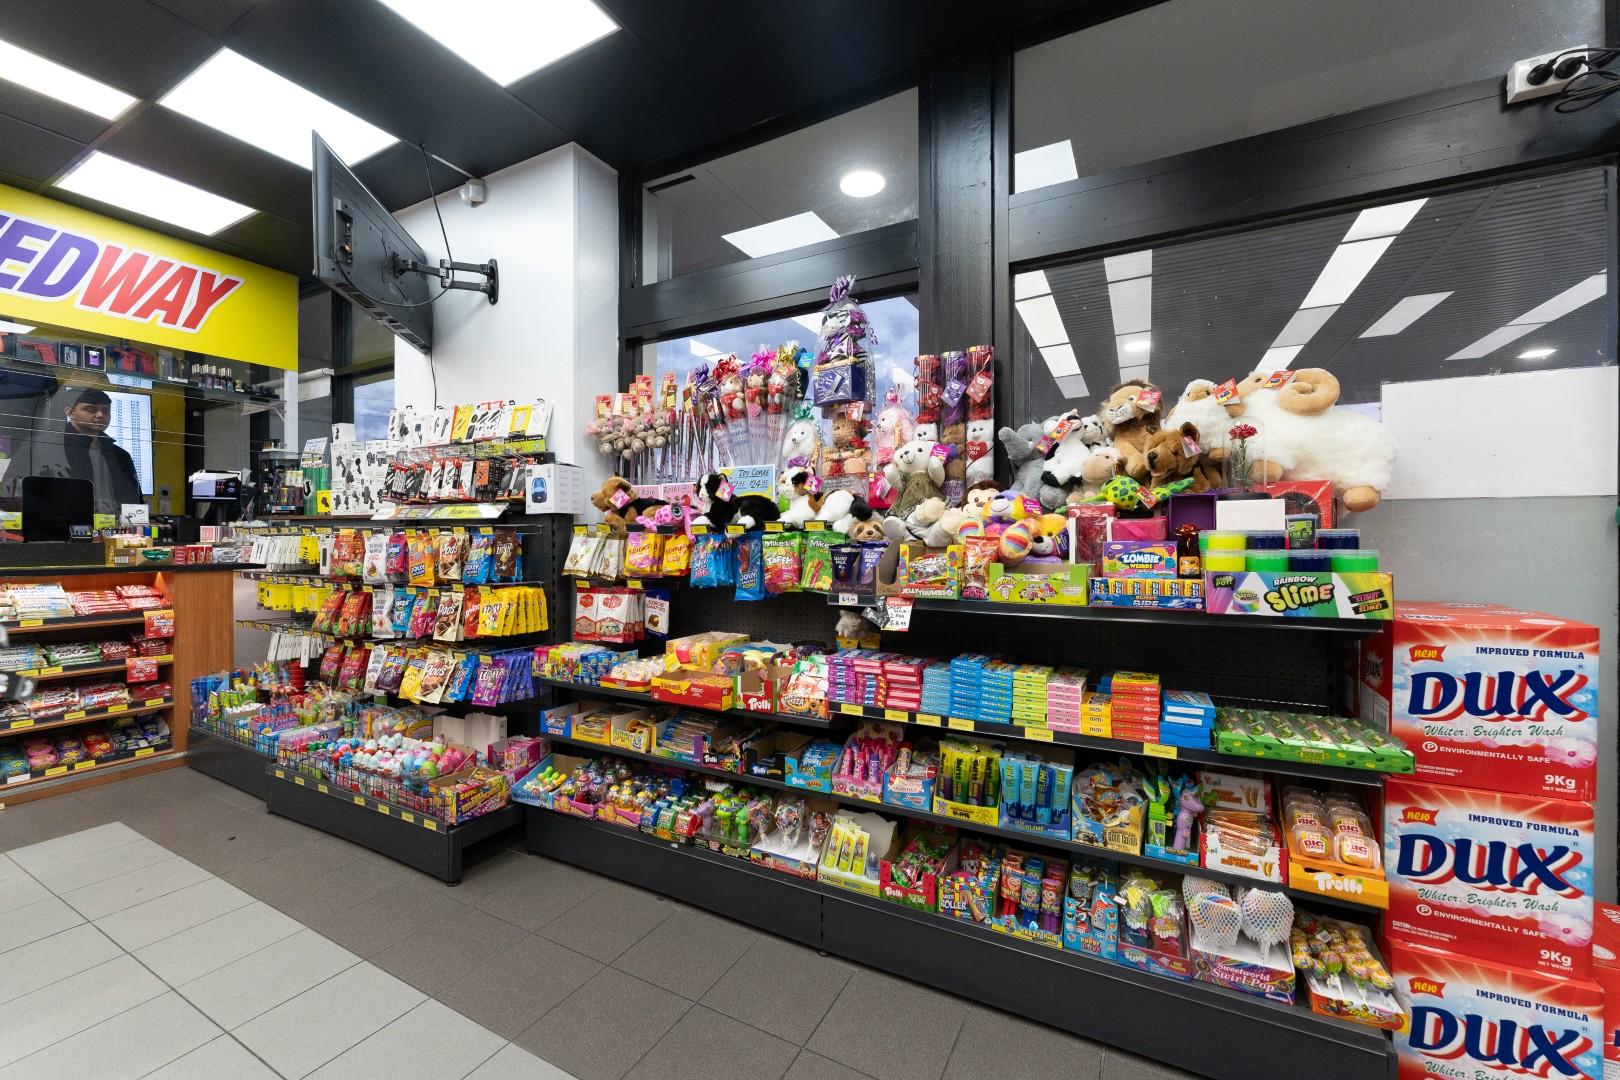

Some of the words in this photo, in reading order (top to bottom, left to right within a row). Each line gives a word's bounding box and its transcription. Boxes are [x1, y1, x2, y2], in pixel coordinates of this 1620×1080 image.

[1121, 553, 1161, 563] ZOMBIE
[1273, 576, 1317, 586] RAINBOW
[1414, 649, 1437, 658] new
[1476, 647, 1529, 657] IMPROVED
[1533, 649, 1585, 660] FORMULA
[1408, 670, 1576, 717] DUX
[748, 698, 771, 710] Trolli
[1473, 725, 1522, 739] Brighter
[1528, 724, 1564, 736] Wash
[1440, 746, 1524, 760] ENVIRONMENTALLY
[1544, 774, 1576, 789] 9Kg
[1298, 818, 1317, 826] BIG
[1407, 811, 1430, 823] new
[1339, 824, 1359, 832] BIG
[1468, 814, 1523, 829] IMPROVED
[1526, 822, 1580, 837] FORMULA
[1396, 833, 1570, 892] DUX
[1314, 872, 1363, 894] Trolli
[885, 887, 903, 897] Trolli
[941, 900, 967, 910] ROLLER
[1467, 894, 1517, 910] Brighter
[1522, 898, 1559, 912] Wash
[1434, 911, 1518, 933] ENVIRONMENTALLY
[1522, 929, 1547, 939] SAFE
[1540, 949, 1572, 966] 9Kg
[1217, 963, 1271, 982] Sweetworld
[1549, 963, 1573, 972] WEIGHT
[1414, 981, 1437, 993] new
[1476, 989, 1532, 1009] IMPROVED
[1535, 1003, 1589, 1022] FORMULA
[1409, 1005, 1580, 1076] DUX
